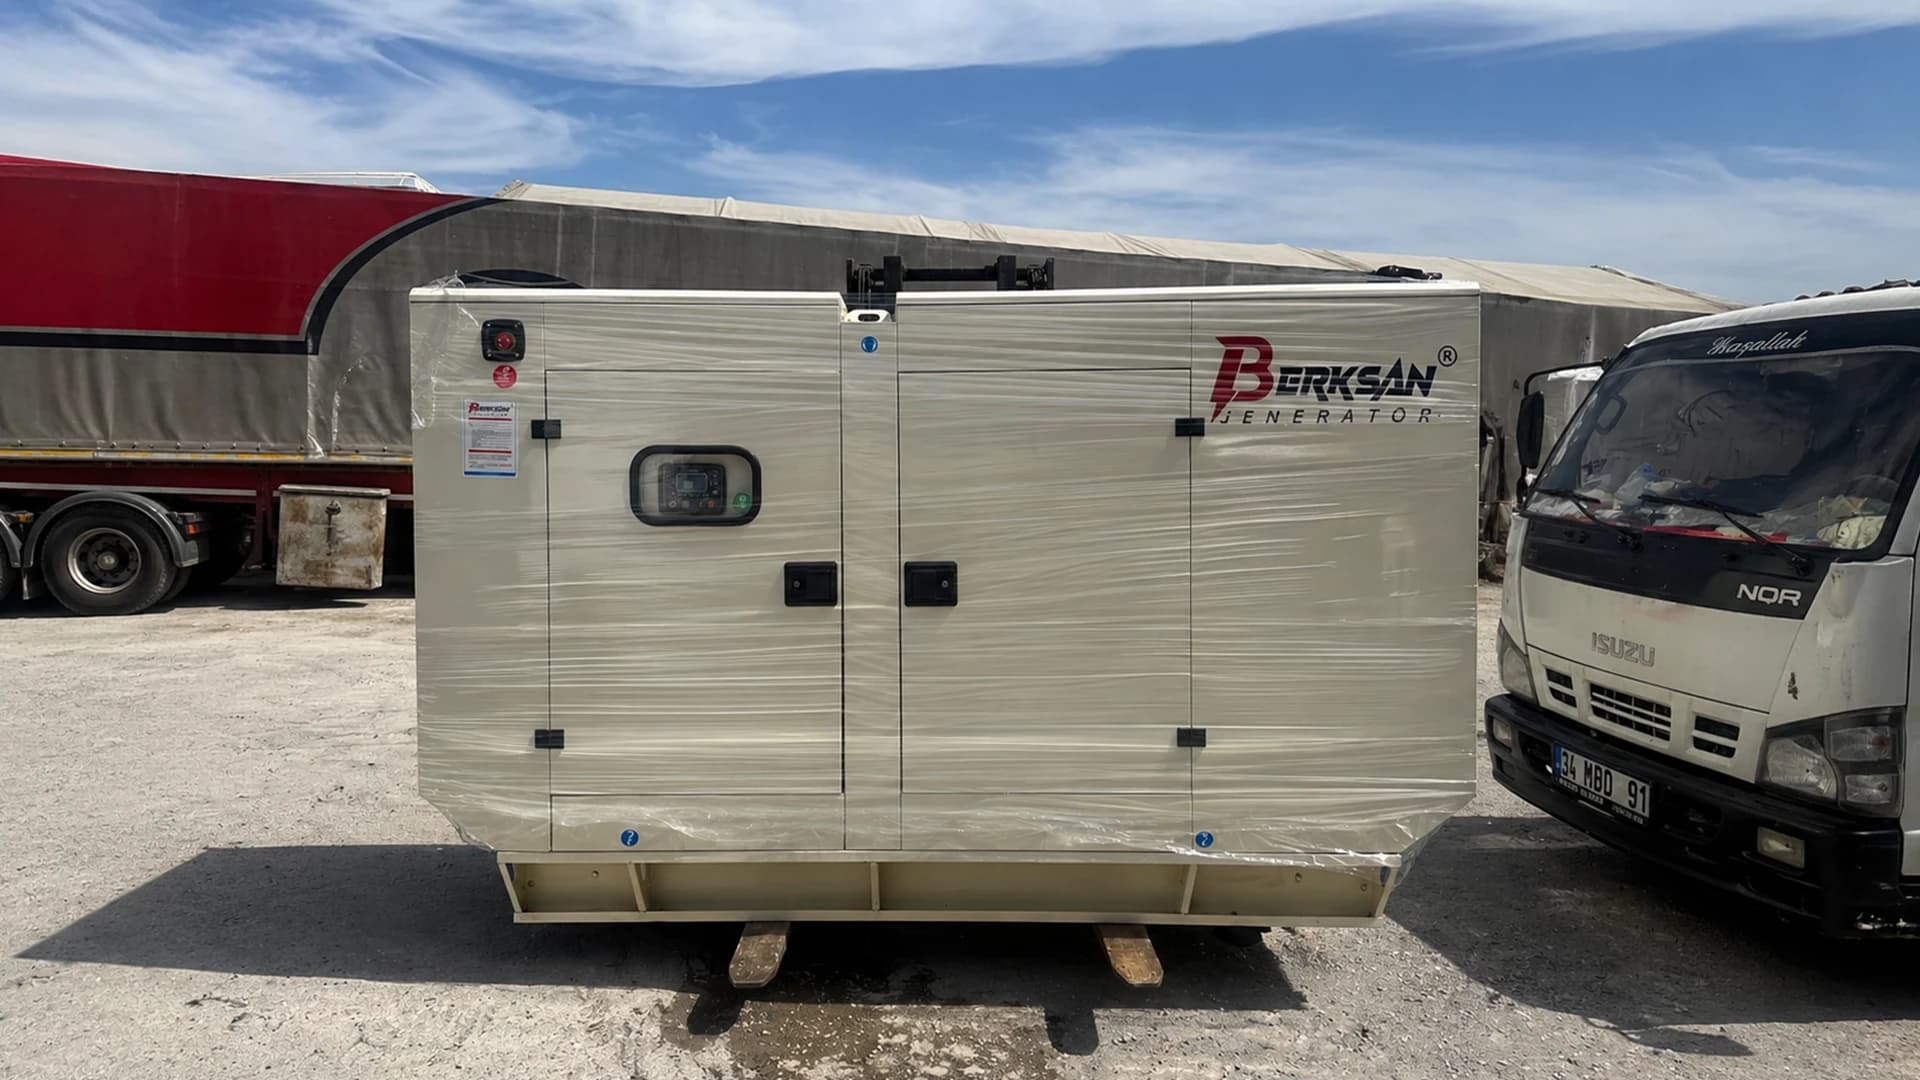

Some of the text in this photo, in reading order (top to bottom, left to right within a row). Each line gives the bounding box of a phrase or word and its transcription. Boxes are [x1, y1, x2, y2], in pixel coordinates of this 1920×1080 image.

[1210, 336, 1437, 422] BERKSAN
[1736, 583, 1802, 606] NQR
[1592, 632, 1656, 667] ISUZU
[1562, 750, 1576, 780] 34
[1584, 760, 1613, 797] MBD
[1628, 780, 1646, 813] 91
